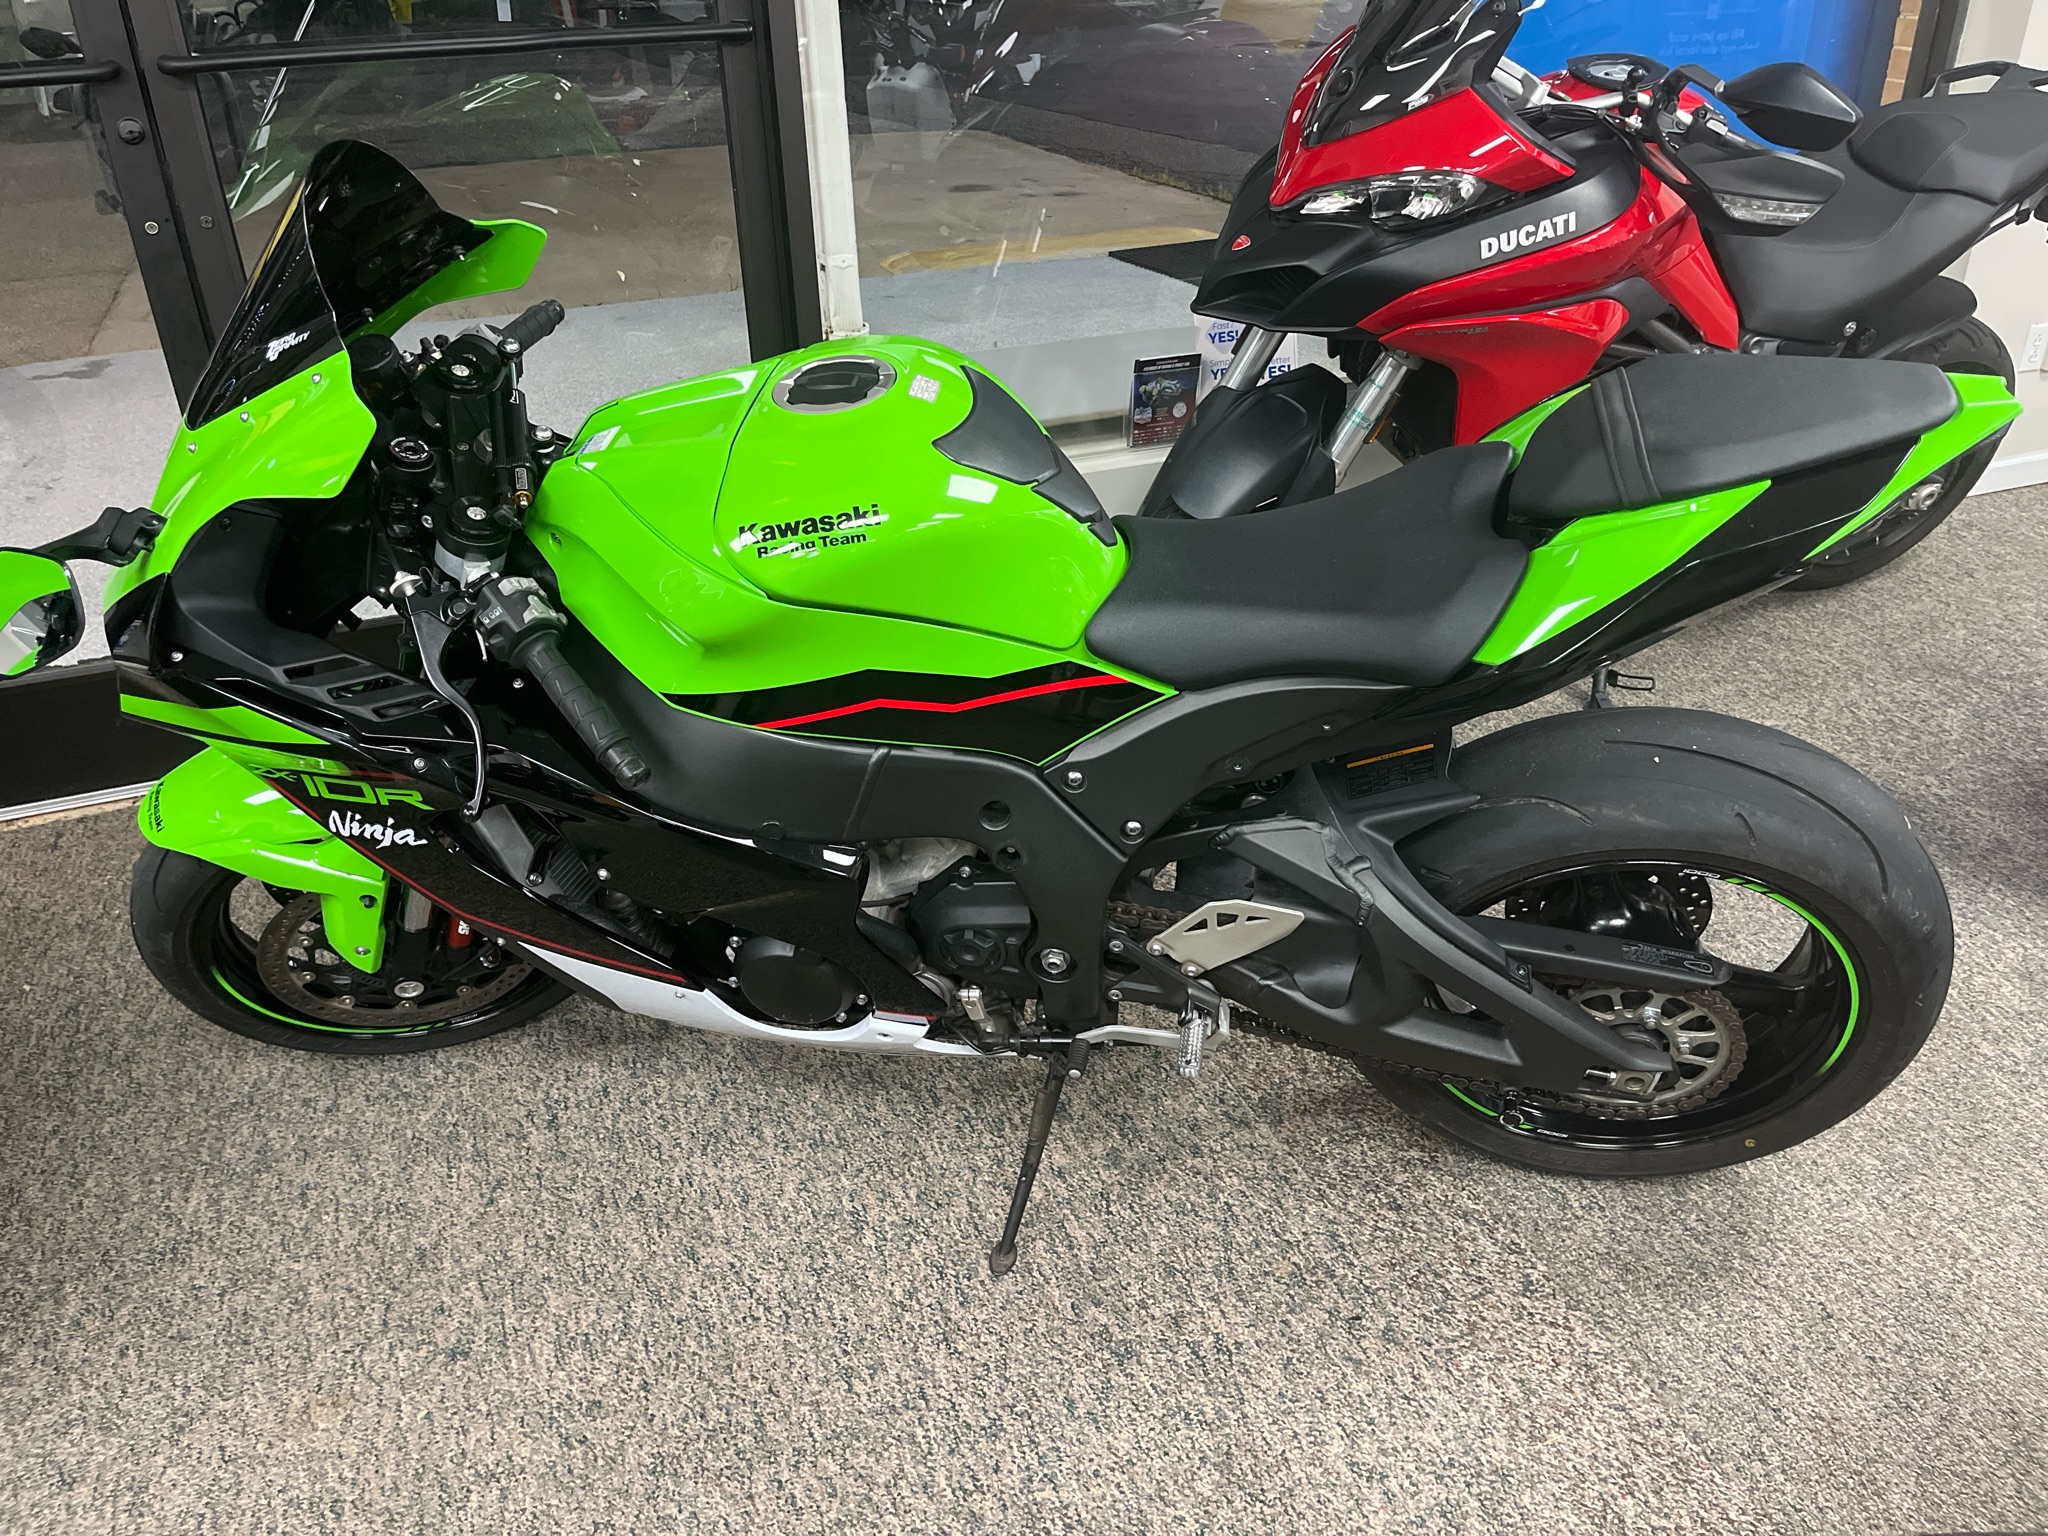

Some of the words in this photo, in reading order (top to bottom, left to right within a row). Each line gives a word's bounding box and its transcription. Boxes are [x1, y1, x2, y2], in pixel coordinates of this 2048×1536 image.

[1480, 211, 1577, 260] DUCATI
[1208, 329, 1239, 344] YES!
[1209, 358, 1232, 368] Simp
[1270, 356, 1291, 365] etter
[1262, 364, 1292, 380] ES!
[739, 503, 882, 548] Kawasaki
[756, 540, 817, 558] Ring
[818, 532, 868, 548] Team
[154, 780, 166, 833] Kawasaki
[328, 810, 428, 850] Ninja
[1682, 868, 1721, 879] 1000
